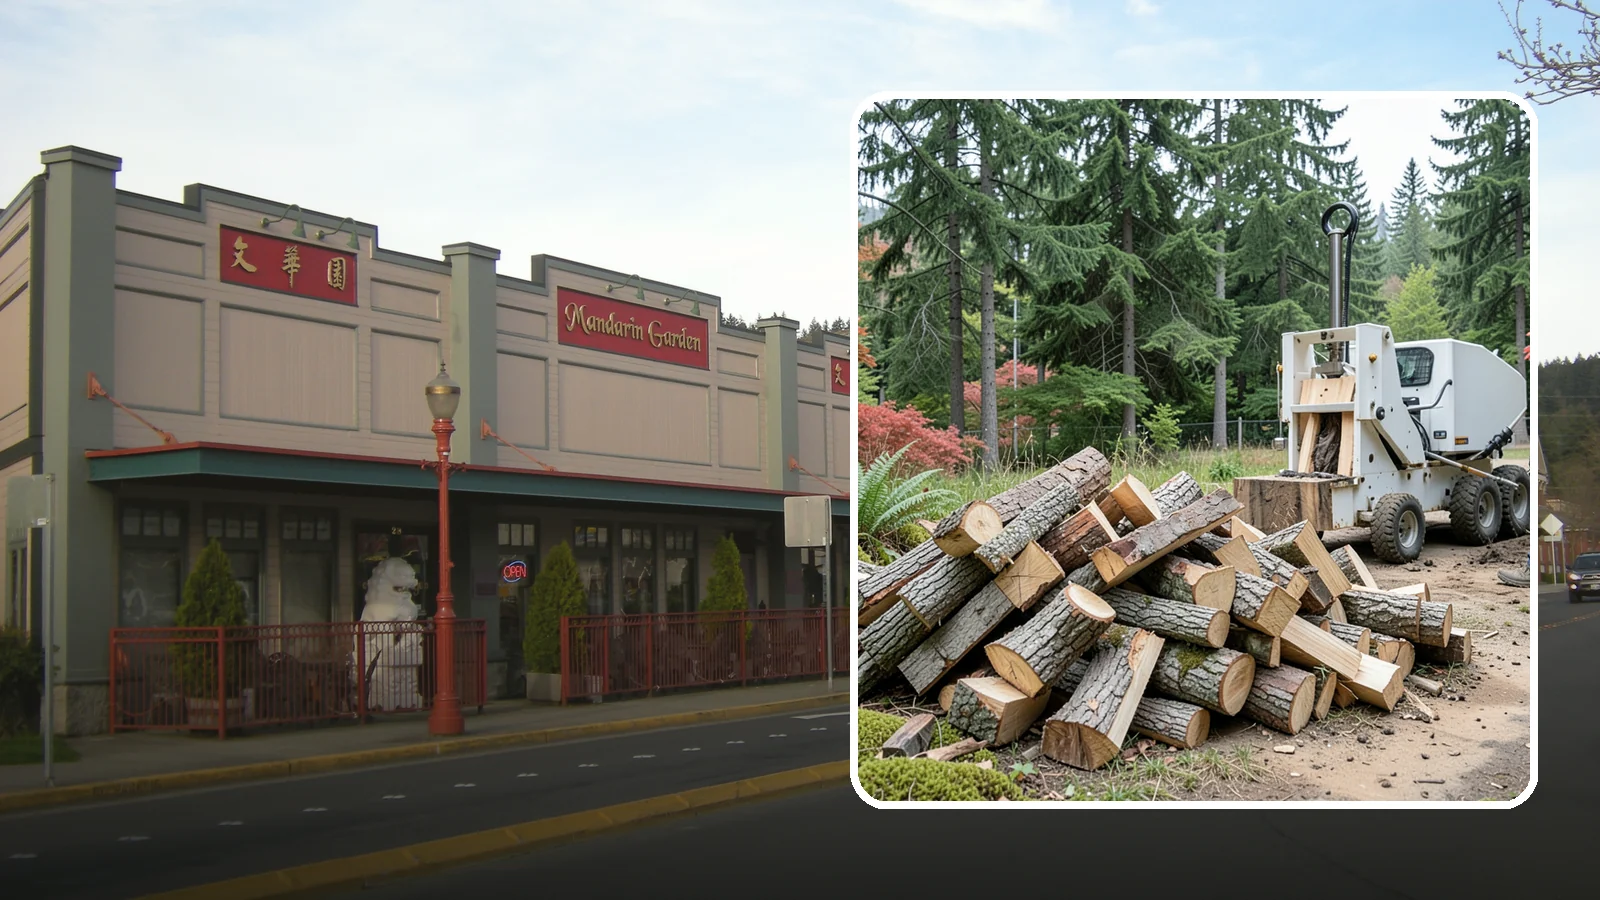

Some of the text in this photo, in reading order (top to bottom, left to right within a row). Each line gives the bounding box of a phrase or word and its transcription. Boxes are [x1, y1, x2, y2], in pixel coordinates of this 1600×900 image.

[230, 235, 347, 291] 文華園
[564, 302, 702, 352] Mandarin Garden
[503, 565, 527, 578] OPEN
